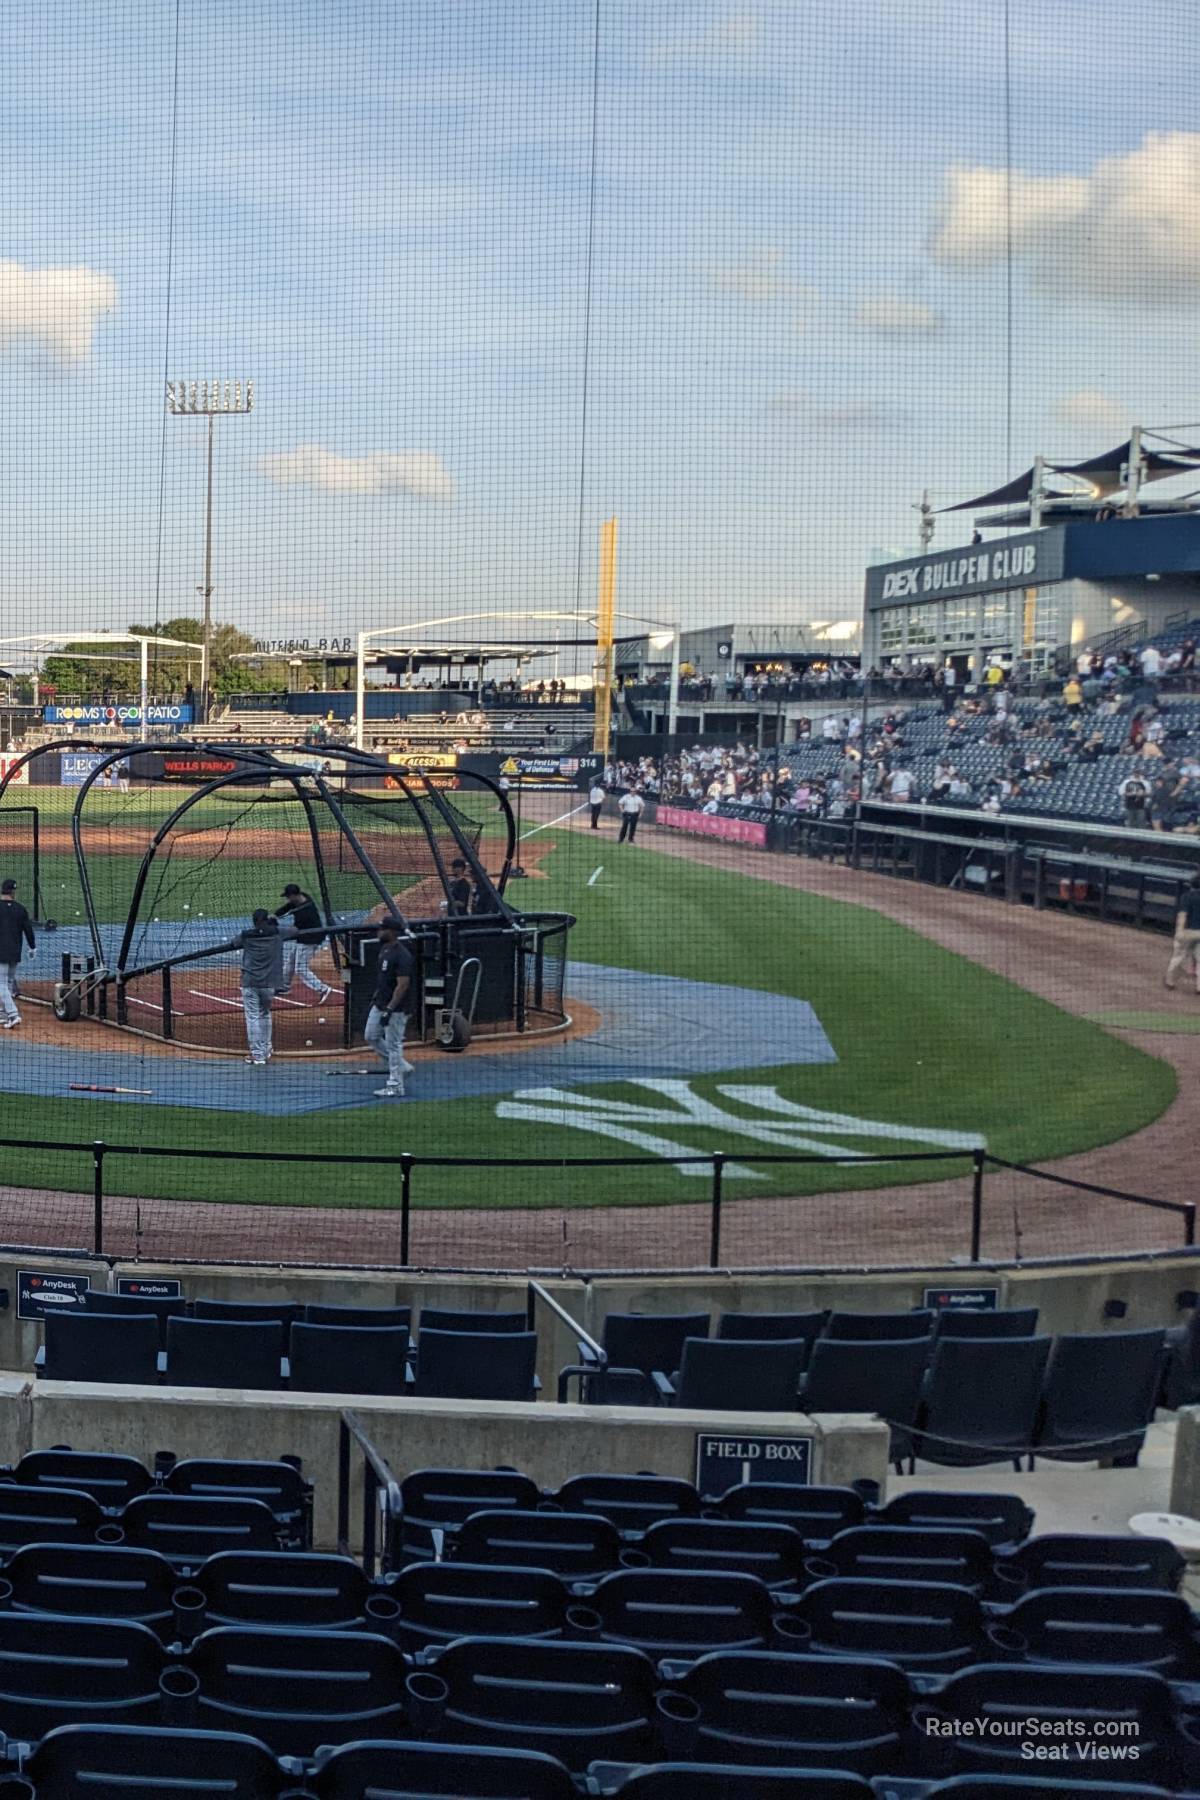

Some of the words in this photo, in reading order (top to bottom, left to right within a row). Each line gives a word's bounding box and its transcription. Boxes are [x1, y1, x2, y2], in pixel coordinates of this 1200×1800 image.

[882, 567, 921, 599] DEX
[923, 554, 990, 592] BULLPEN
[993, 545, 1036, 580] CLUB
[56, 706, 100, 719] ROOMS
[101, 706, 116, 719] TO
[148, 706, 181, 719] PATIO
[164, 761, 199, 772] WELLS
[200, 760, 236, 772] FARGO
[407, 757, 438, 767] ALESSI
[580, 757, 597, 768] 314
[42, 1279, 77, 1290] AnyDesk
[139, 1285, 169, 1294] AnyDesk
[705, 1441, 761, 1459] FIELD
[765, 1444, 804, 1461] BOX
